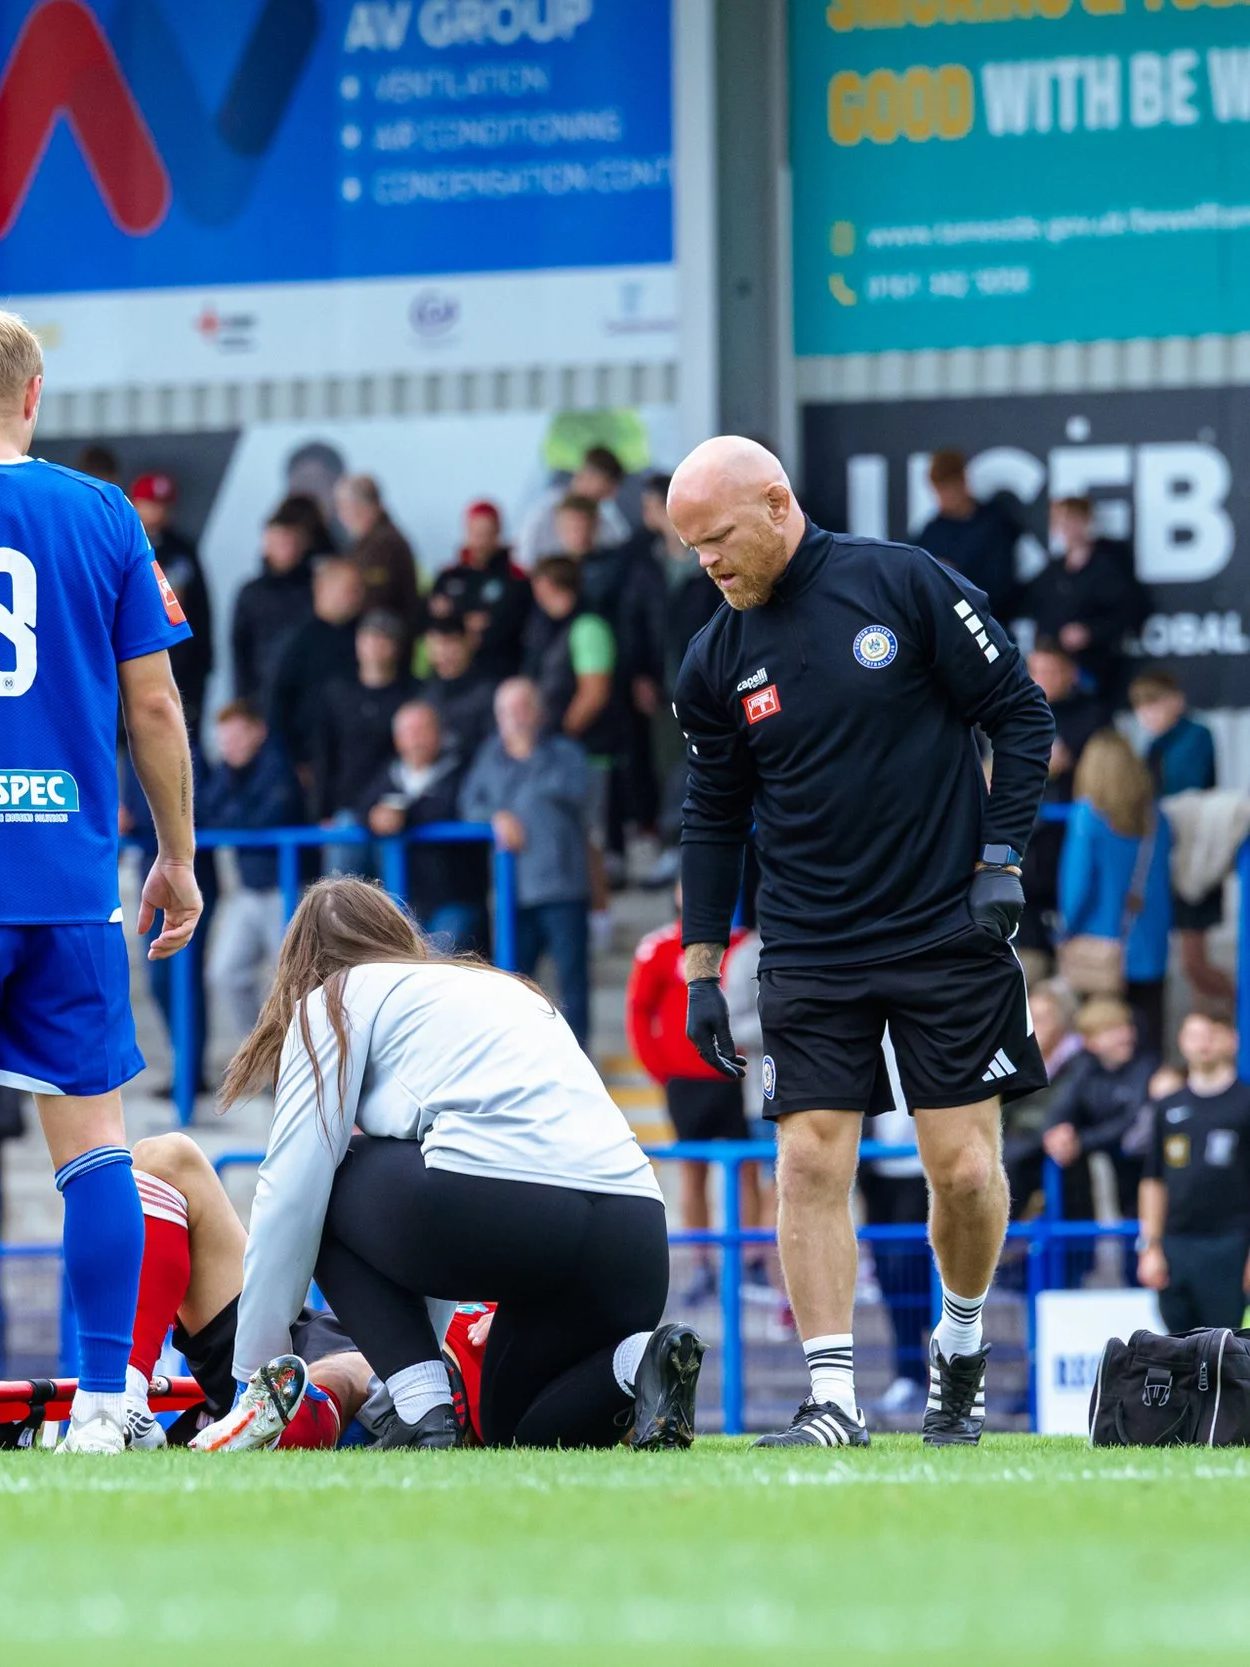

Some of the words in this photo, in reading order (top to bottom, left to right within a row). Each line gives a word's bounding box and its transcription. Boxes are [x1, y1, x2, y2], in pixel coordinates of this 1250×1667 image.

[345, 0, 411, 52] AV
[417, 0, 593, 47] GROUP
[827, 63, 975, 147] GOOD
[981, 55, 1121, 136] WITH
[1130, 49, 1200, 128] BE
[737, 667, 768, 691] capelli
